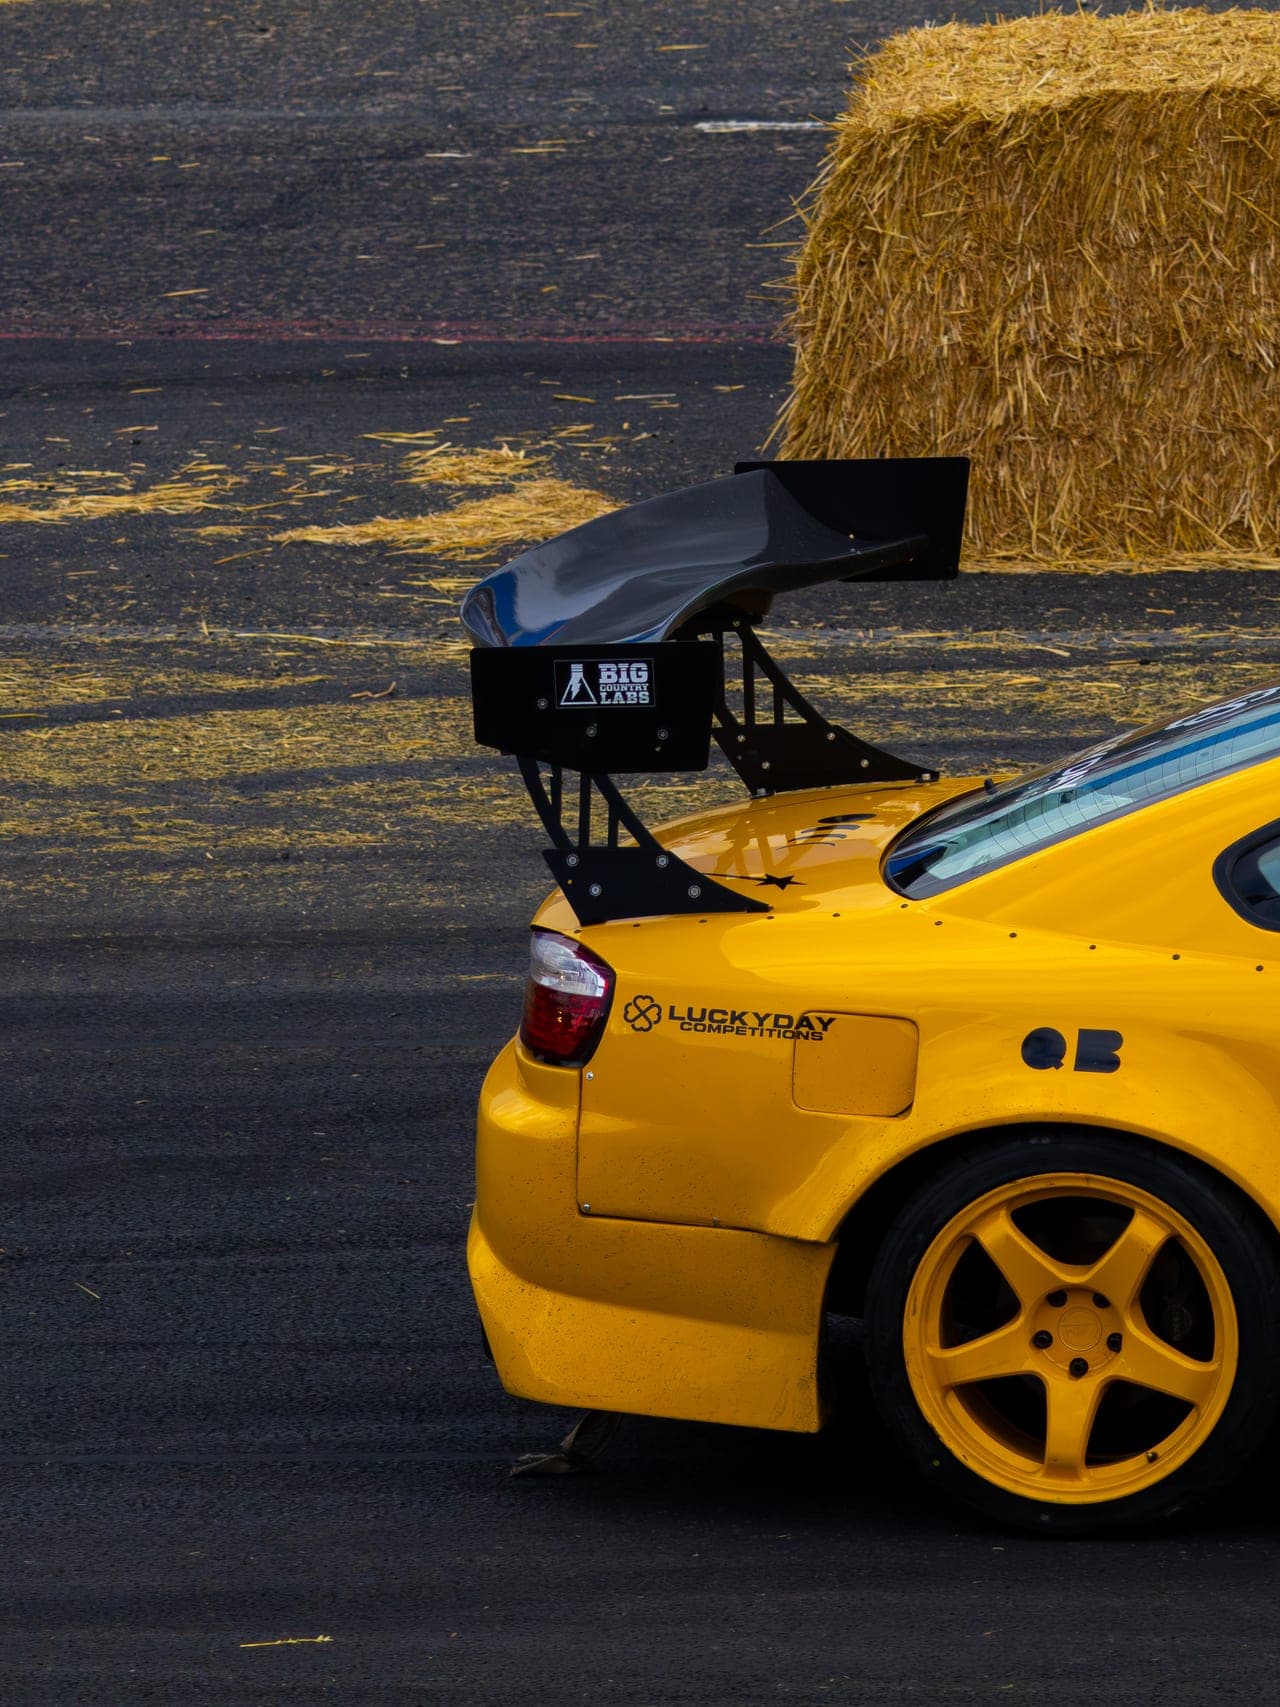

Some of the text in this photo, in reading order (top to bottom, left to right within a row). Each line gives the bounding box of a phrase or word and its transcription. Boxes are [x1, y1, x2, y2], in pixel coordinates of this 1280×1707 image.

[598, 662, 649, 684] BIG
[599, 683, 650, 692] COUNTRY
[599, 691, 650, 705] LABS
[668, 1004, 837, 1032] LUCKYDAY
[679, 1021, 825, 1041] COMPETITIONS
